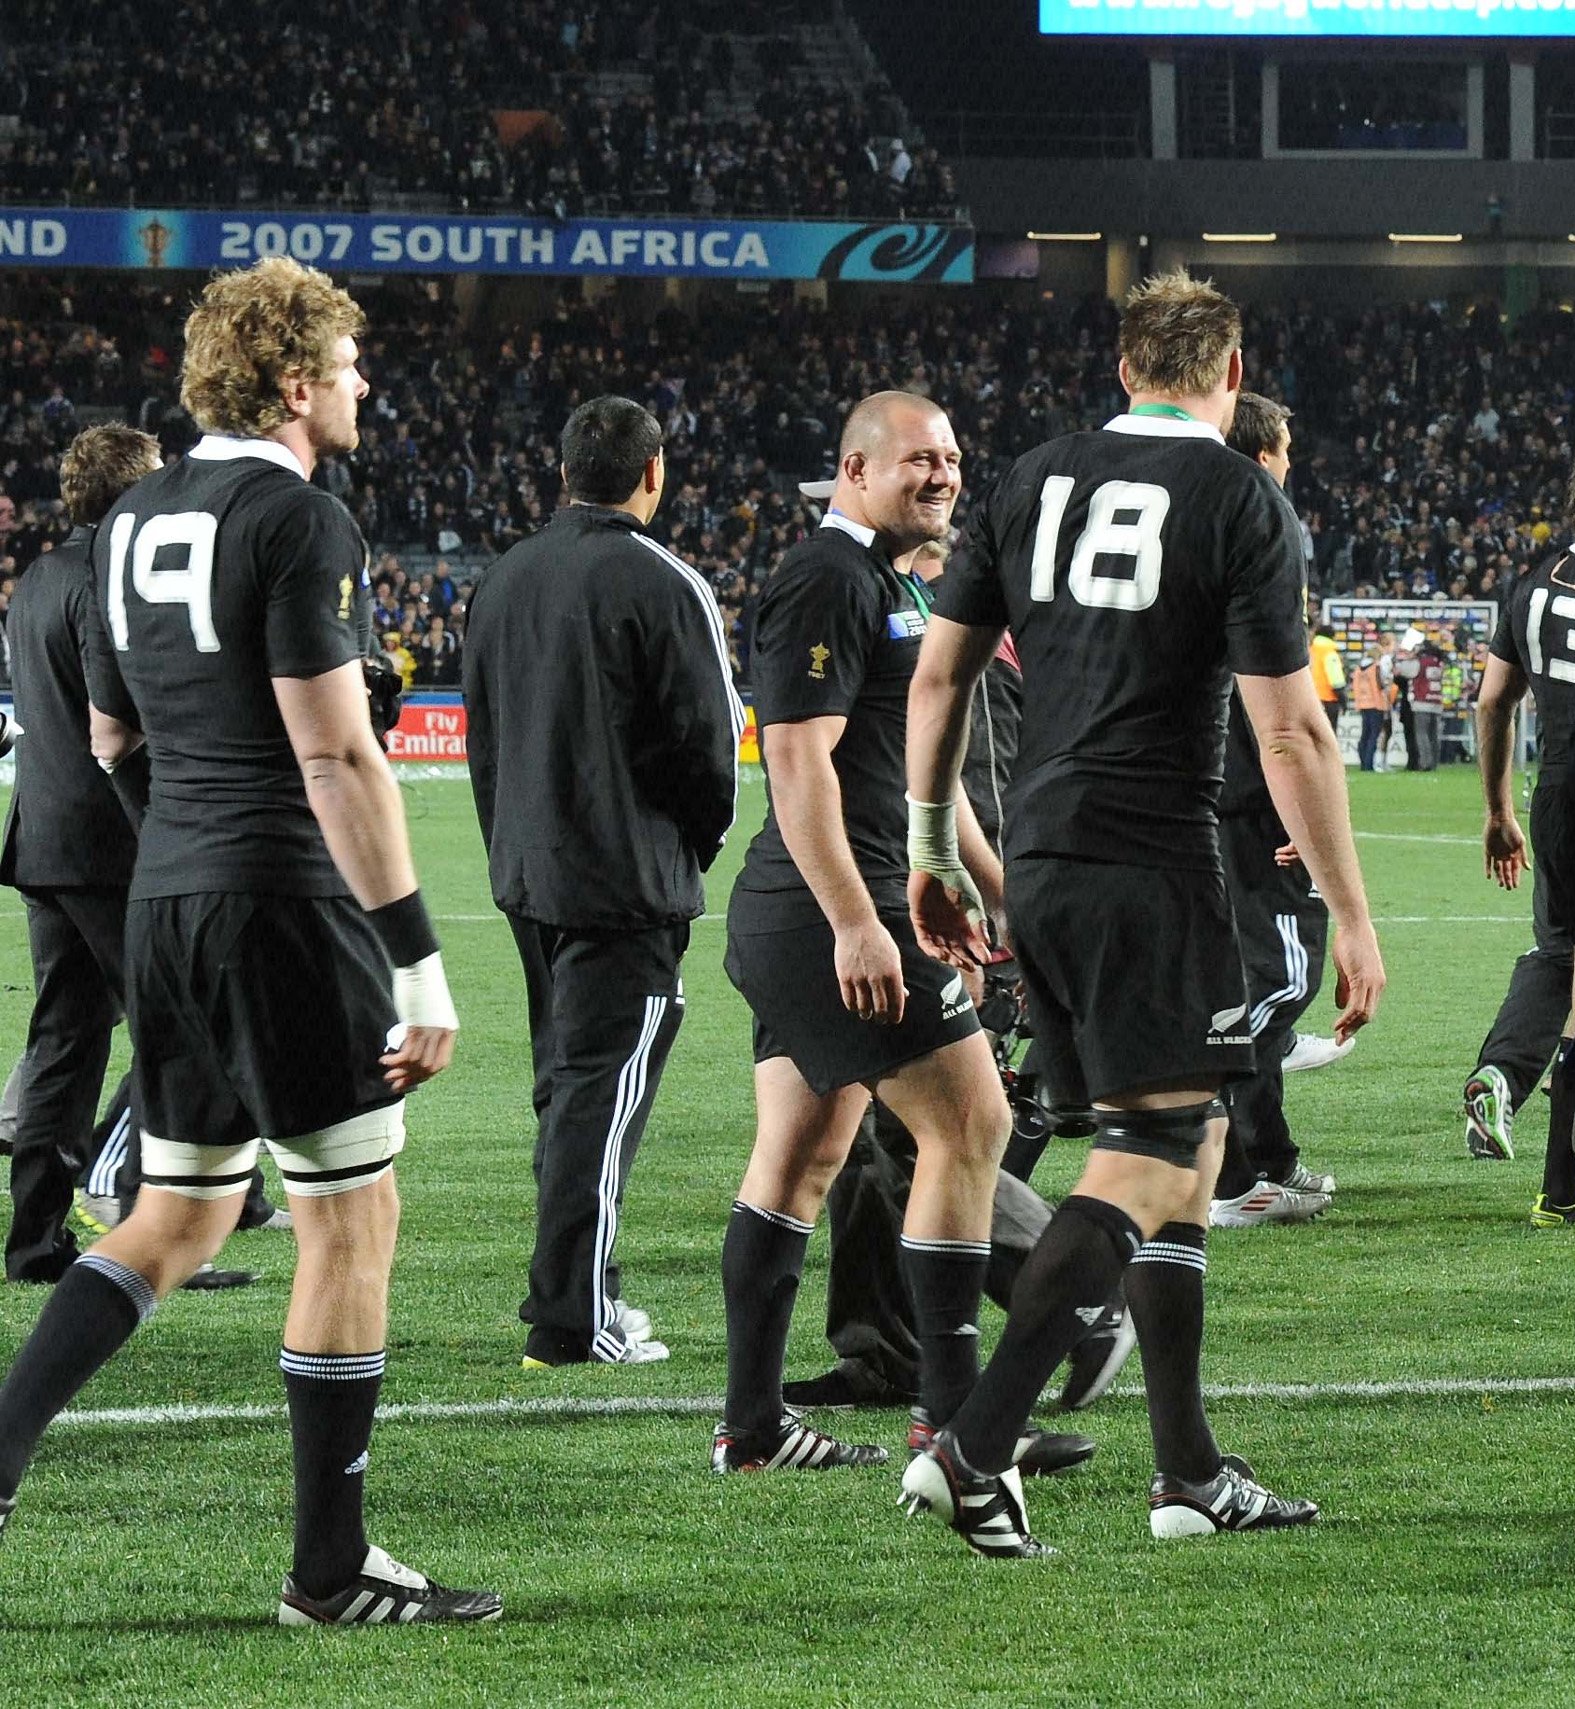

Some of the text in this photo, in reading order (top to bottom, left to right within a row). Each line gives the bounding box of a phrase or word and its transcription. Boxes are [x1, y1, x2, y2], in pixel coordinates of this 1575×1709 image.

[220, 222, 770, 267] 2007 SOUTH AFRICA
[1030, 475, 1171, 611] 18
[108, 511, 221, 653] 19
[386, 730, 467, 755] Emira
[424, 711, 458, 733] Fly
